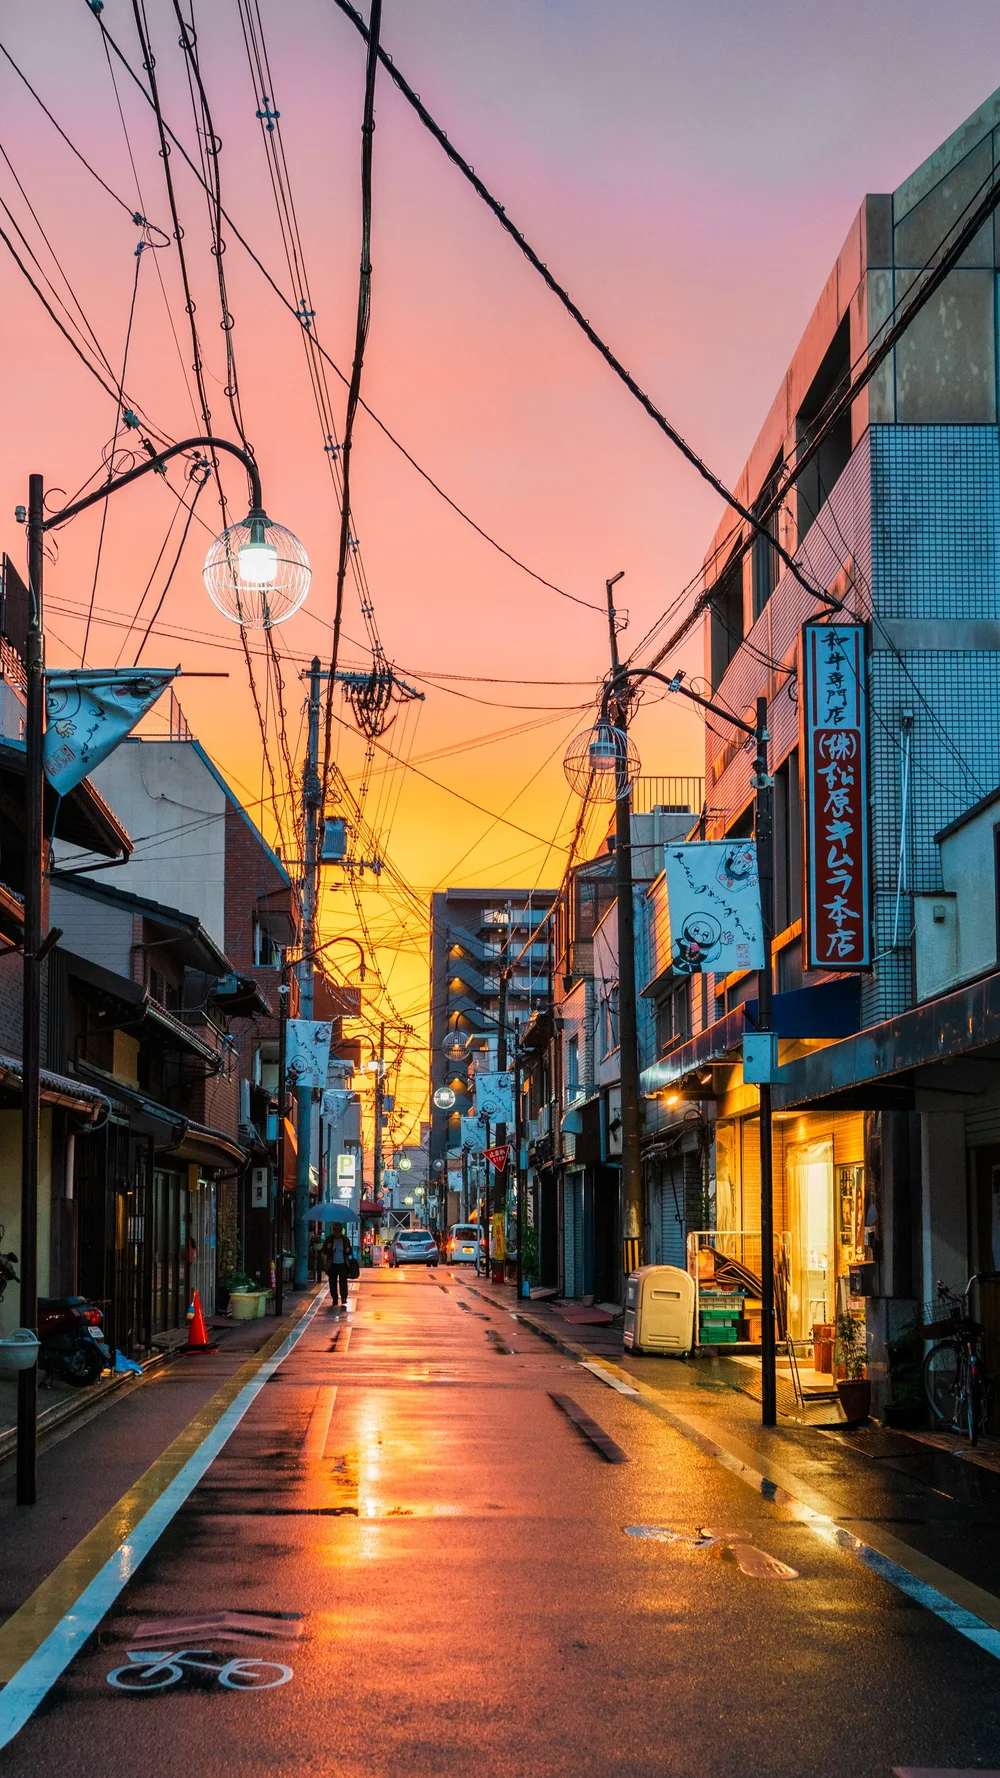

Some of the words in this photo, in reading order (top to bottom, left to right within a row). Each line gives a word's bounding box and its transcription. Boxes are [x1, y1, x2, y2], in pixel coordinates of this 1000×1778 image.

[821, 631, 850, 726] 和牛専門店
[489, 1149, 505, 1157] 止まれ
[340, 1156, 353, 1173] P
